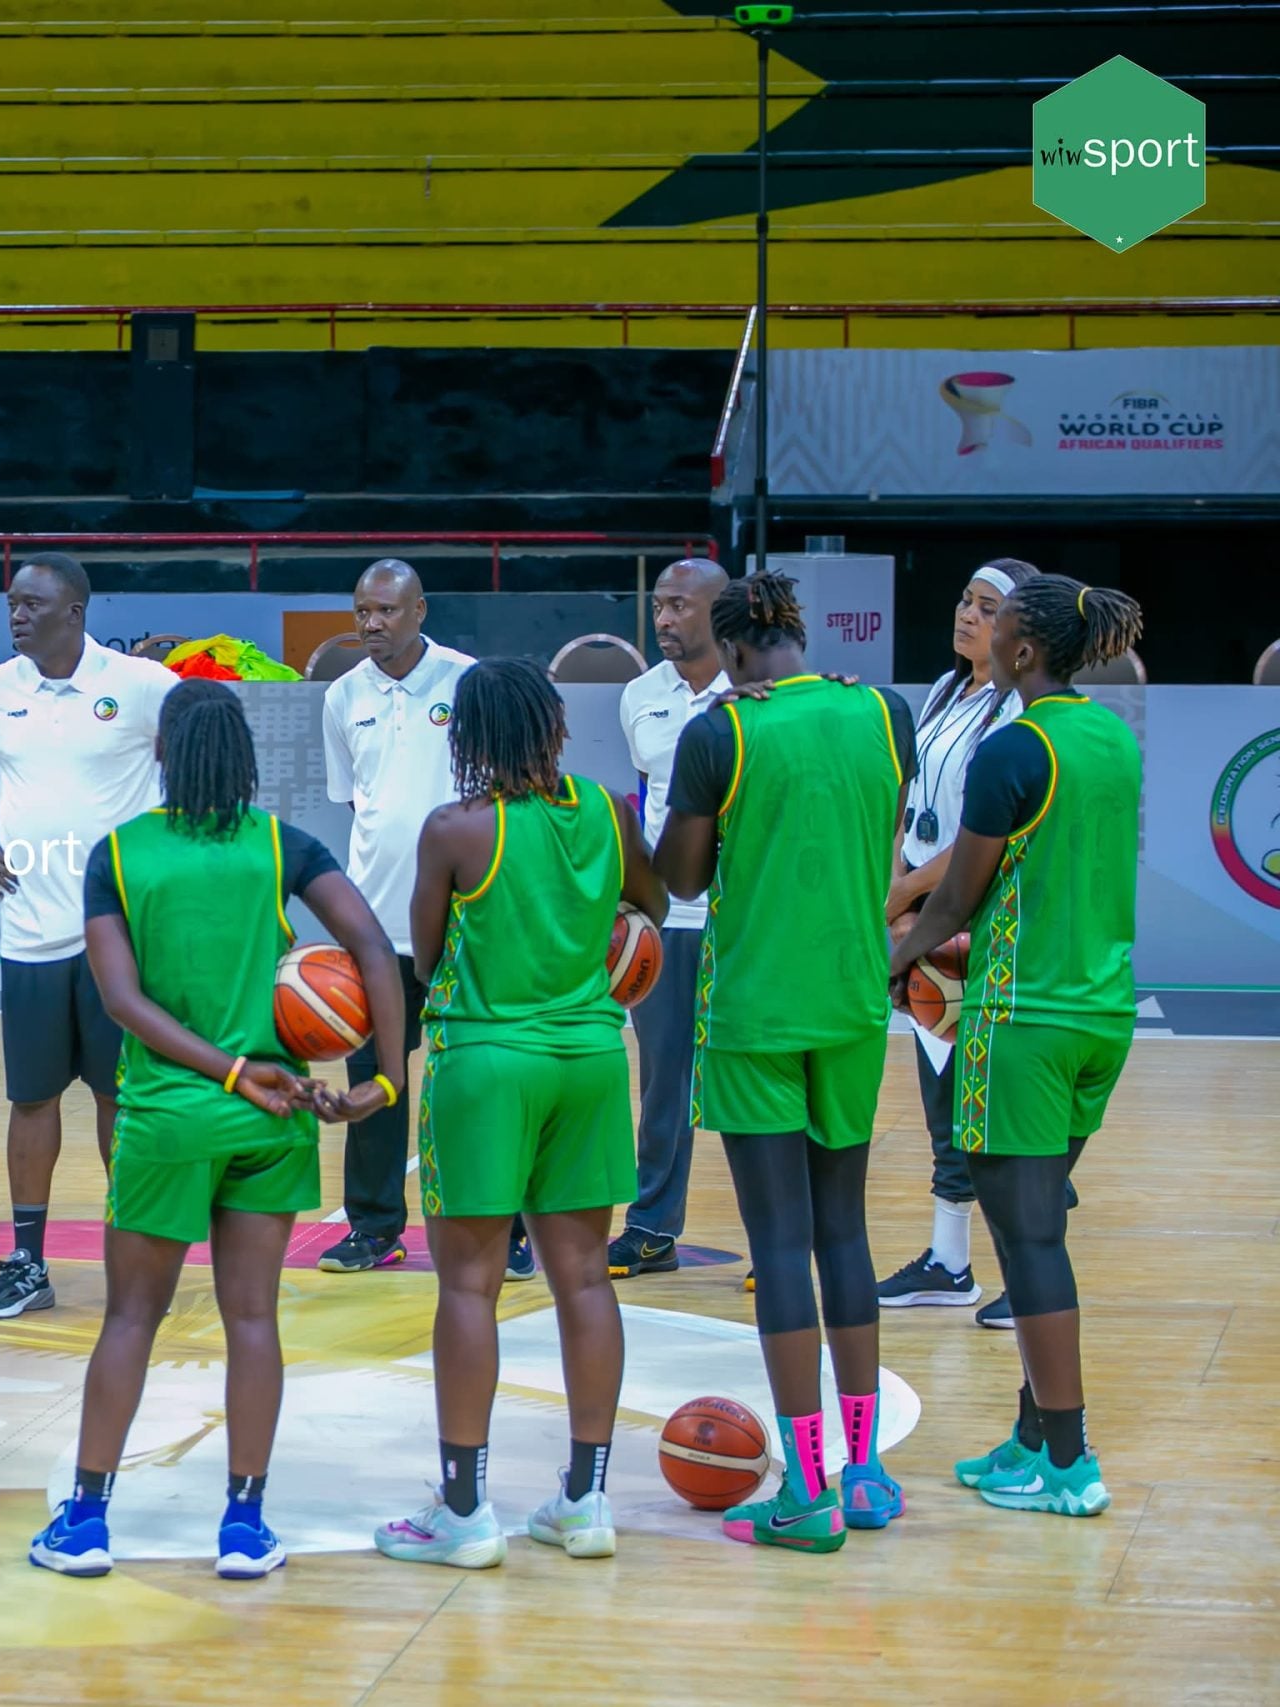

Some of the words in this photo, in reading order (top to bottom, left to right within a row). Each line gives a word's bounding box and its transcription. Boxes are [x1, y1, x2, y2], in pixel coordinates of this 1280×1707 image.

[1123, 398, 1158, 410] FIBA
[1059, 422, 1162, 436] WORLD
[1168, 422, 1224, 436] CUP
[1058, 438, 1126, 450] AFRICAN
[1130, 438, 1224, 450] QUALIFIERS
[826, 612, 854, 628] STEP
[855, 611, 882, 642] UP
[842, 628, 854, 643] IT
